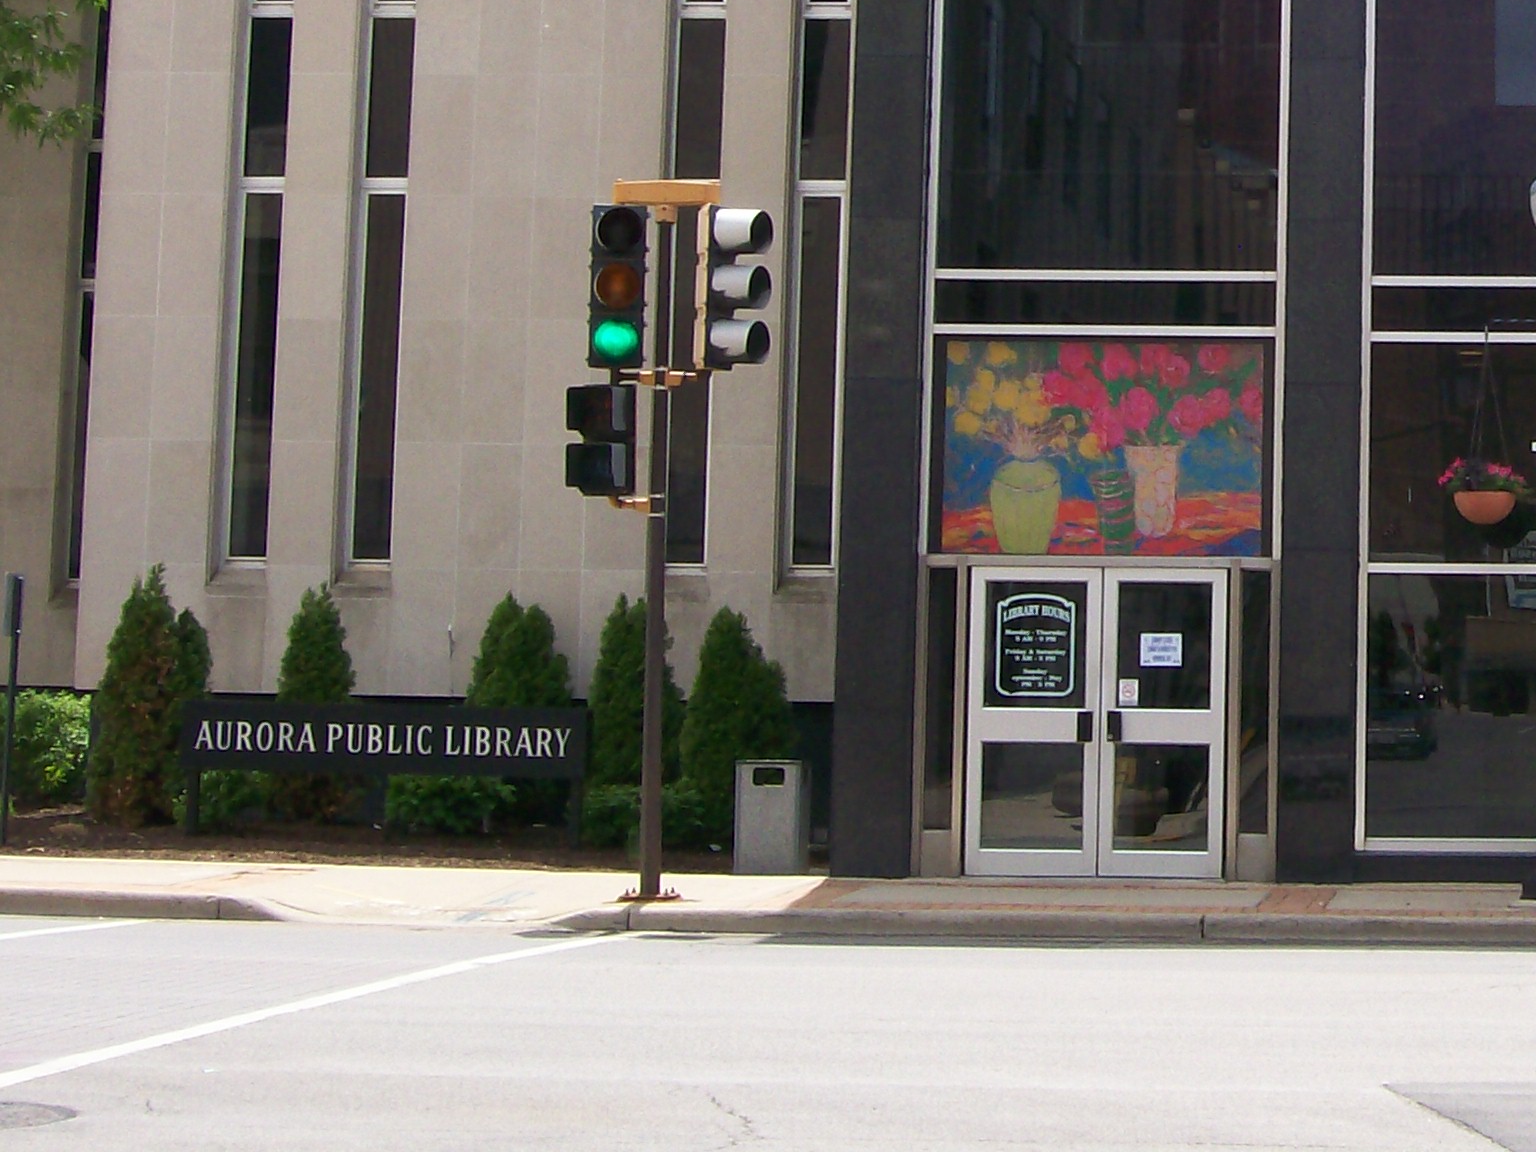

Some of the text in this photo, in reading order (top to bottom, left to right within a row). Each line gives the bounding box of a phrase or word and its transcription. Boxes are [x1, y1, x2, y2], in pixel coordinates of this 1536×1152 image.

[1003, 604, 1071, 623] LIBRARY HOURS
[193, 719, 572, 759] AURORA PUBLIC LIBRARY
